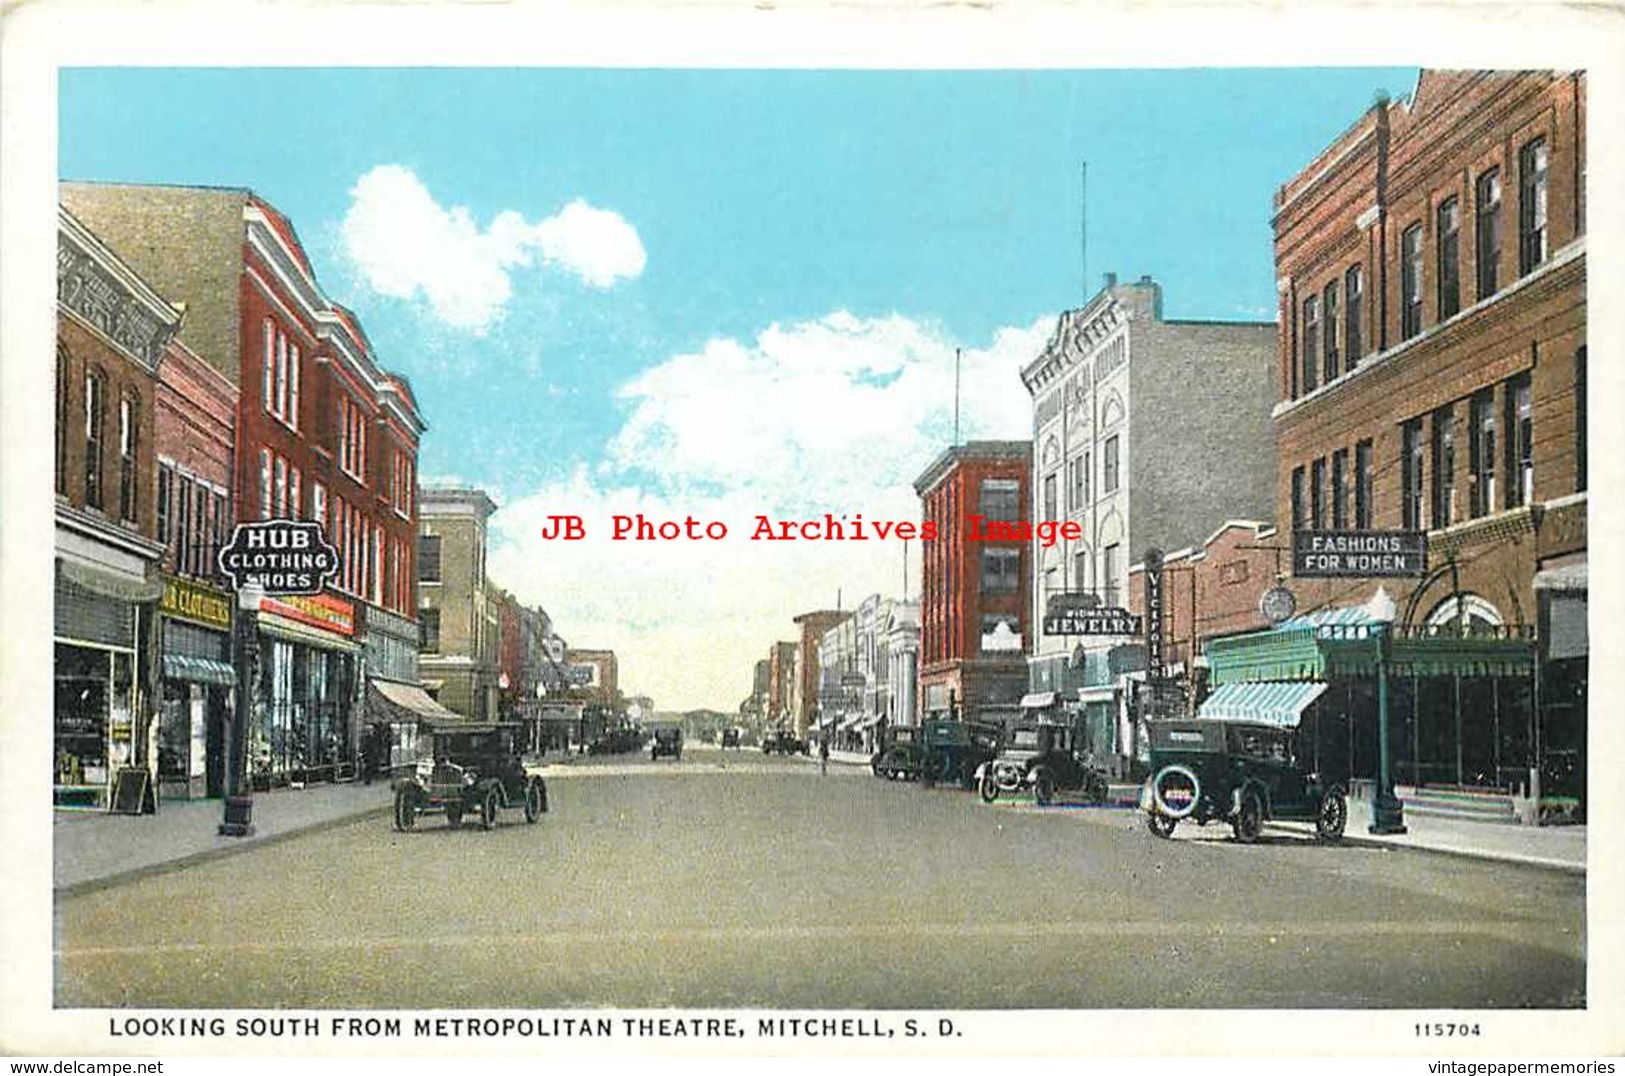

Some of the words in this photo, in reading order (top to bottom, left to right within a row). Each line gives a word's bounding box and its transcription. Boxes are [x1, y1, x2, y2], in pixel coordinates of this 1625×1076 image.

[247, 529, 310, 548] HUB
[1312, 536, 1401, 552] FASHIONS
[229, 553, 328, 569] CLOTHING
[1305, 554, 1340, 569] FOR
[1345, 554, 1405, 570] WOMEN
[246, 573, 311, 588] SHOES
[1047, 618, 1138, 633] JEWELRY
[110, 1018, 225, 1037] LOOKING
[236, 1018, 319, 1037] SOUTH
[332, 1018, 401, 1037] FROM
[414, 1018, 612, 1037] METROPOLITAN
[622, 1018, 745, 1038] THEATRE,
[758, 1018, 894, 1038] MITCHELL,
[904, 1018, 927, 1037] S.
[938, 1018, 962, 1037] D.
[1415, 1023, 1481, 1037] 115704
